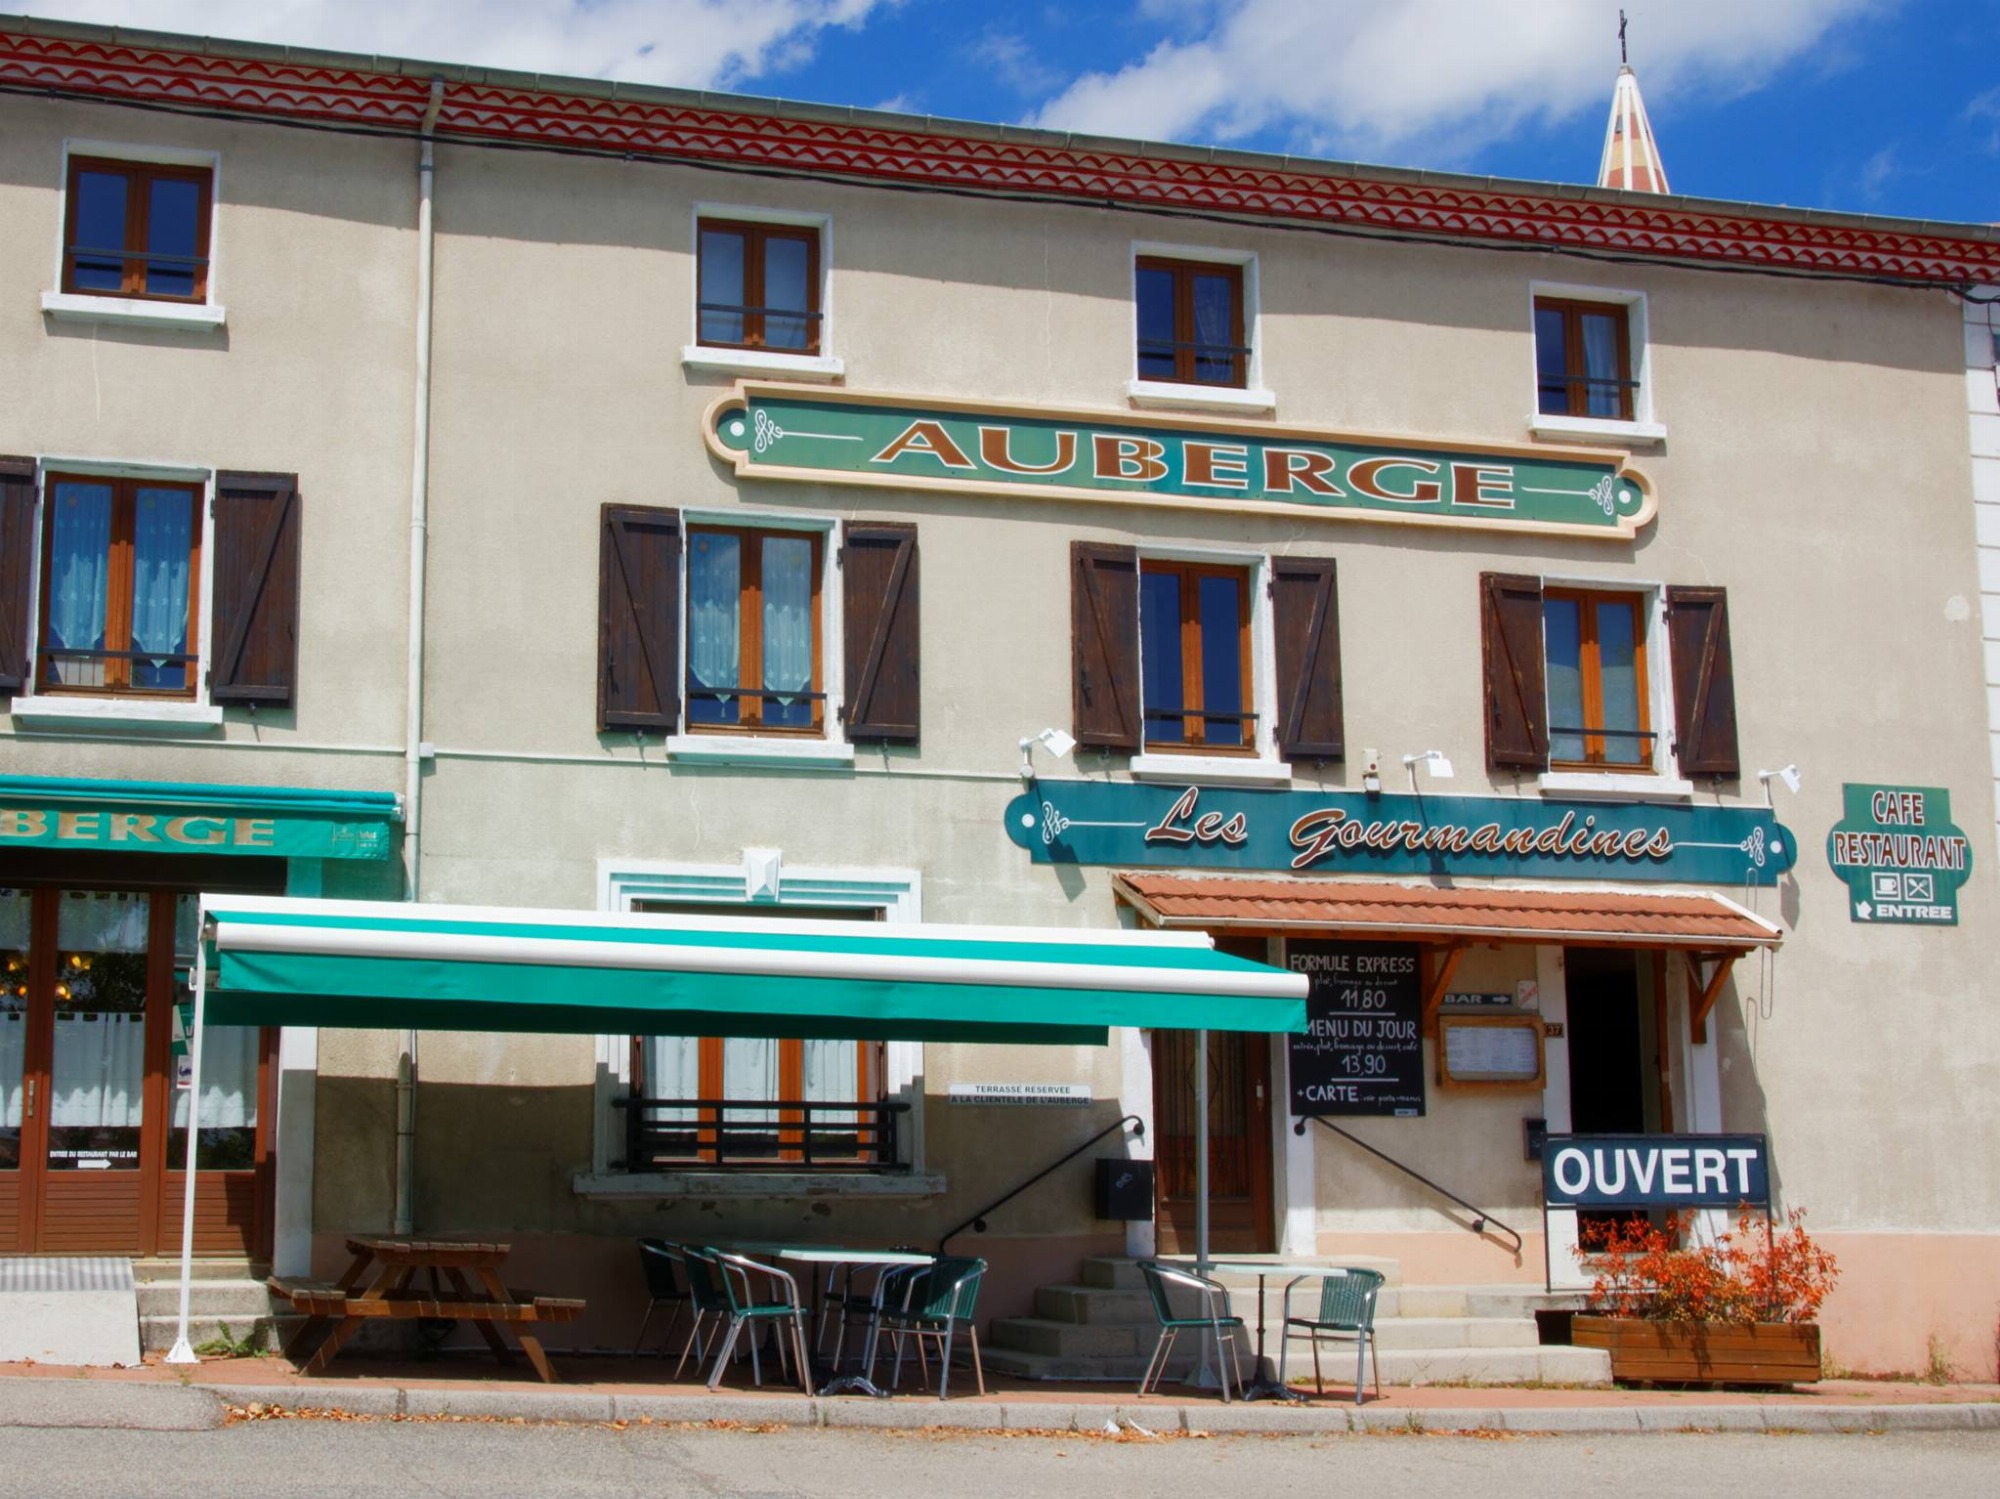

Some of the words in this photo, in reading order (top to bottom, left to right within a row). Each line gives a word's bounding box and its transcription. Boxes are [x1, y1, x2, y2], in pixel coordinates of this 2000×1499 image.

[870, 418, 1517, 509] AUBERGE
[1871, 790, 1925, 825] CAFE
[0, 809, 275, 847] BERGE
[1145, 785, 1247, 844] Les
[1289, 807, 1674, 870] Gourmandines
[1832, 831, 1967, 870] RESTAURANT
[1876, 904, 1952, 919] ENTREE
[1290, 954, 1350, 972] FORMULE
[1357, 956, 1415, 973] EXPRESS
[1444, 994, 1482, 1004] BAR
[1303, 1019, 1349, 1038] MENU
[1353, 1020, 1373, 1038] DU
[1376, 1020, 1417, 1039] JOUR
[1548, 1024, 1560, 1035] 37
[1341, 1054, 1387, 1076] 13,90
[960, 1096, 971, 1104] LA
[974, 1096, 1023, 1104] CLIENTELE
[1026, 1096, 1037, 1104] DE
[1040, 1097, 1089, 1105] L'AUBERGE
[1025, 1086, 1070, 1094] RESERVEE
[1553, 1148, 1757, 1195] OUVERT
